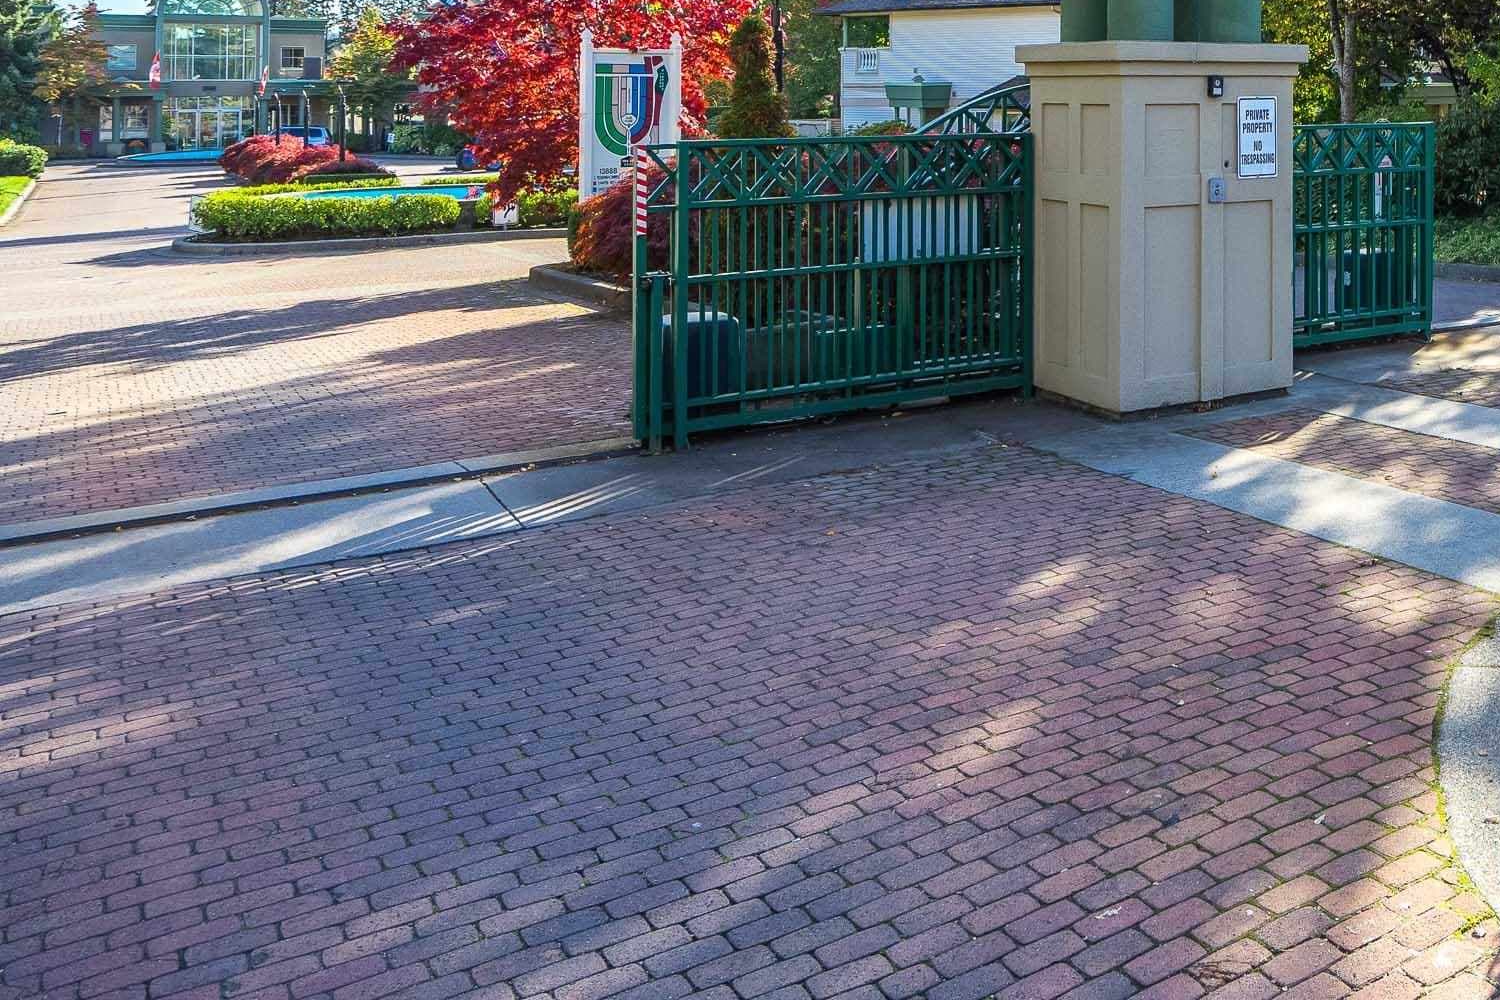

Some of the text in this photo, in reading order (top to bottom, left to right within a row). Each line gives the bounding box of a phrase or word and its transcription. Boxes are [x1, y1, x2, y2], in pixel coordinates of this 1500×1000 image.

[1245, 109, 1270, 121] PRIVATE
[1242, 122, 1273, 134] PROPERTY
[1253, 140, 1263, 152] NO
[1241, 153, 1275, 165] TRESPASSING
